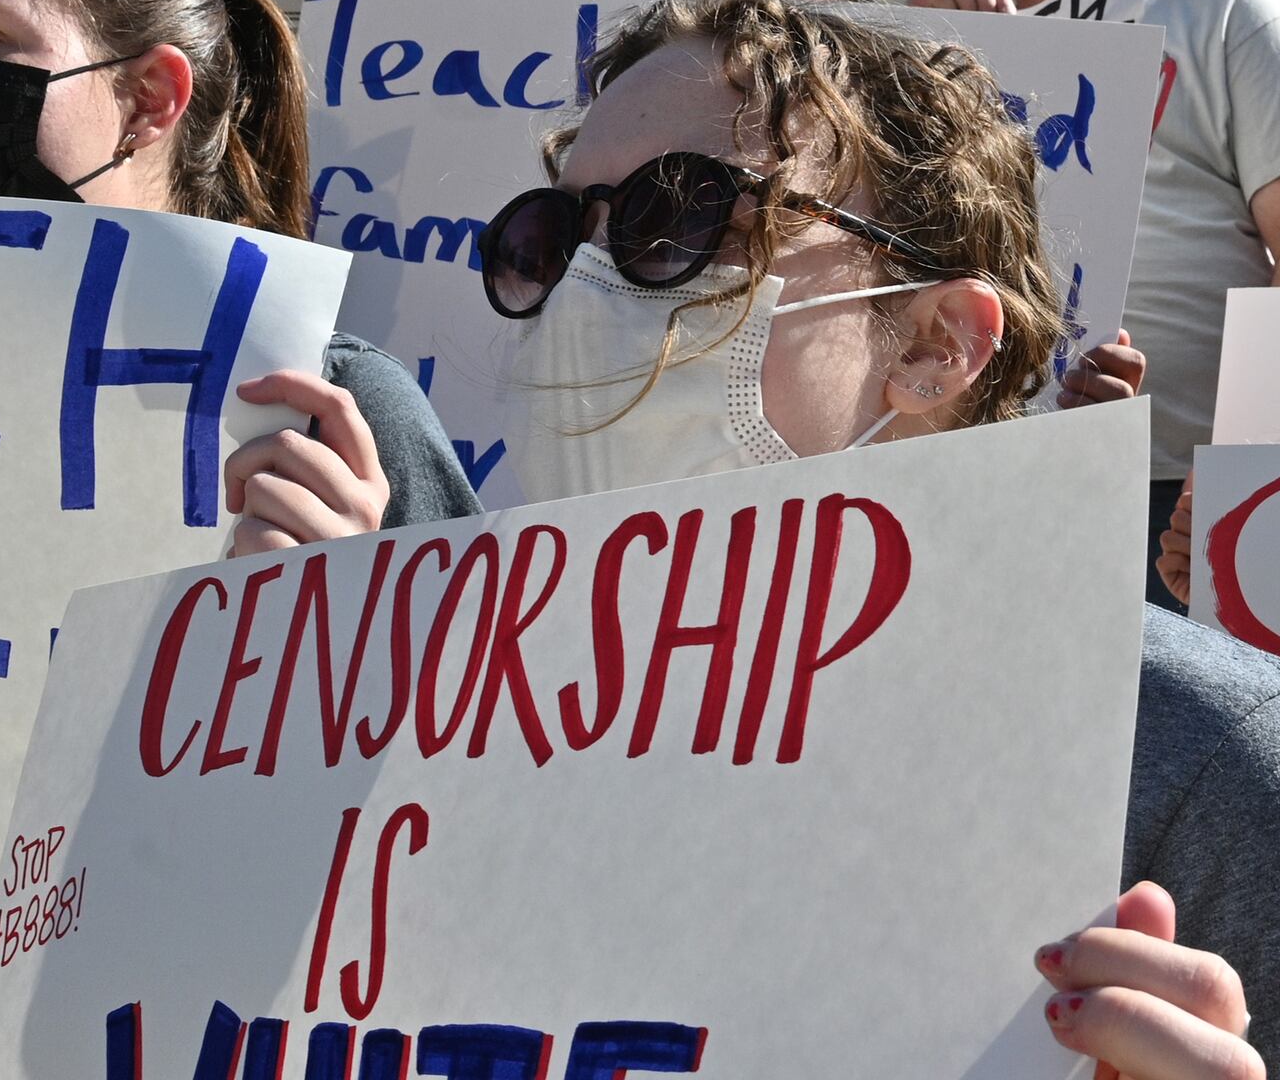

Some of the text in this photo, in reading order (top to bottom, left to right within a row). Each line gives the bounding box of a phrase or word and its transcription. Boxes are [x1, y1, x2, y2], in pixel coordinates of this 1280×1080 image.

[140, 493, 912, 777] CENSORSHIP
[4, 826, 65, 897] STOP
[305, 803, 429, 1020] IS
